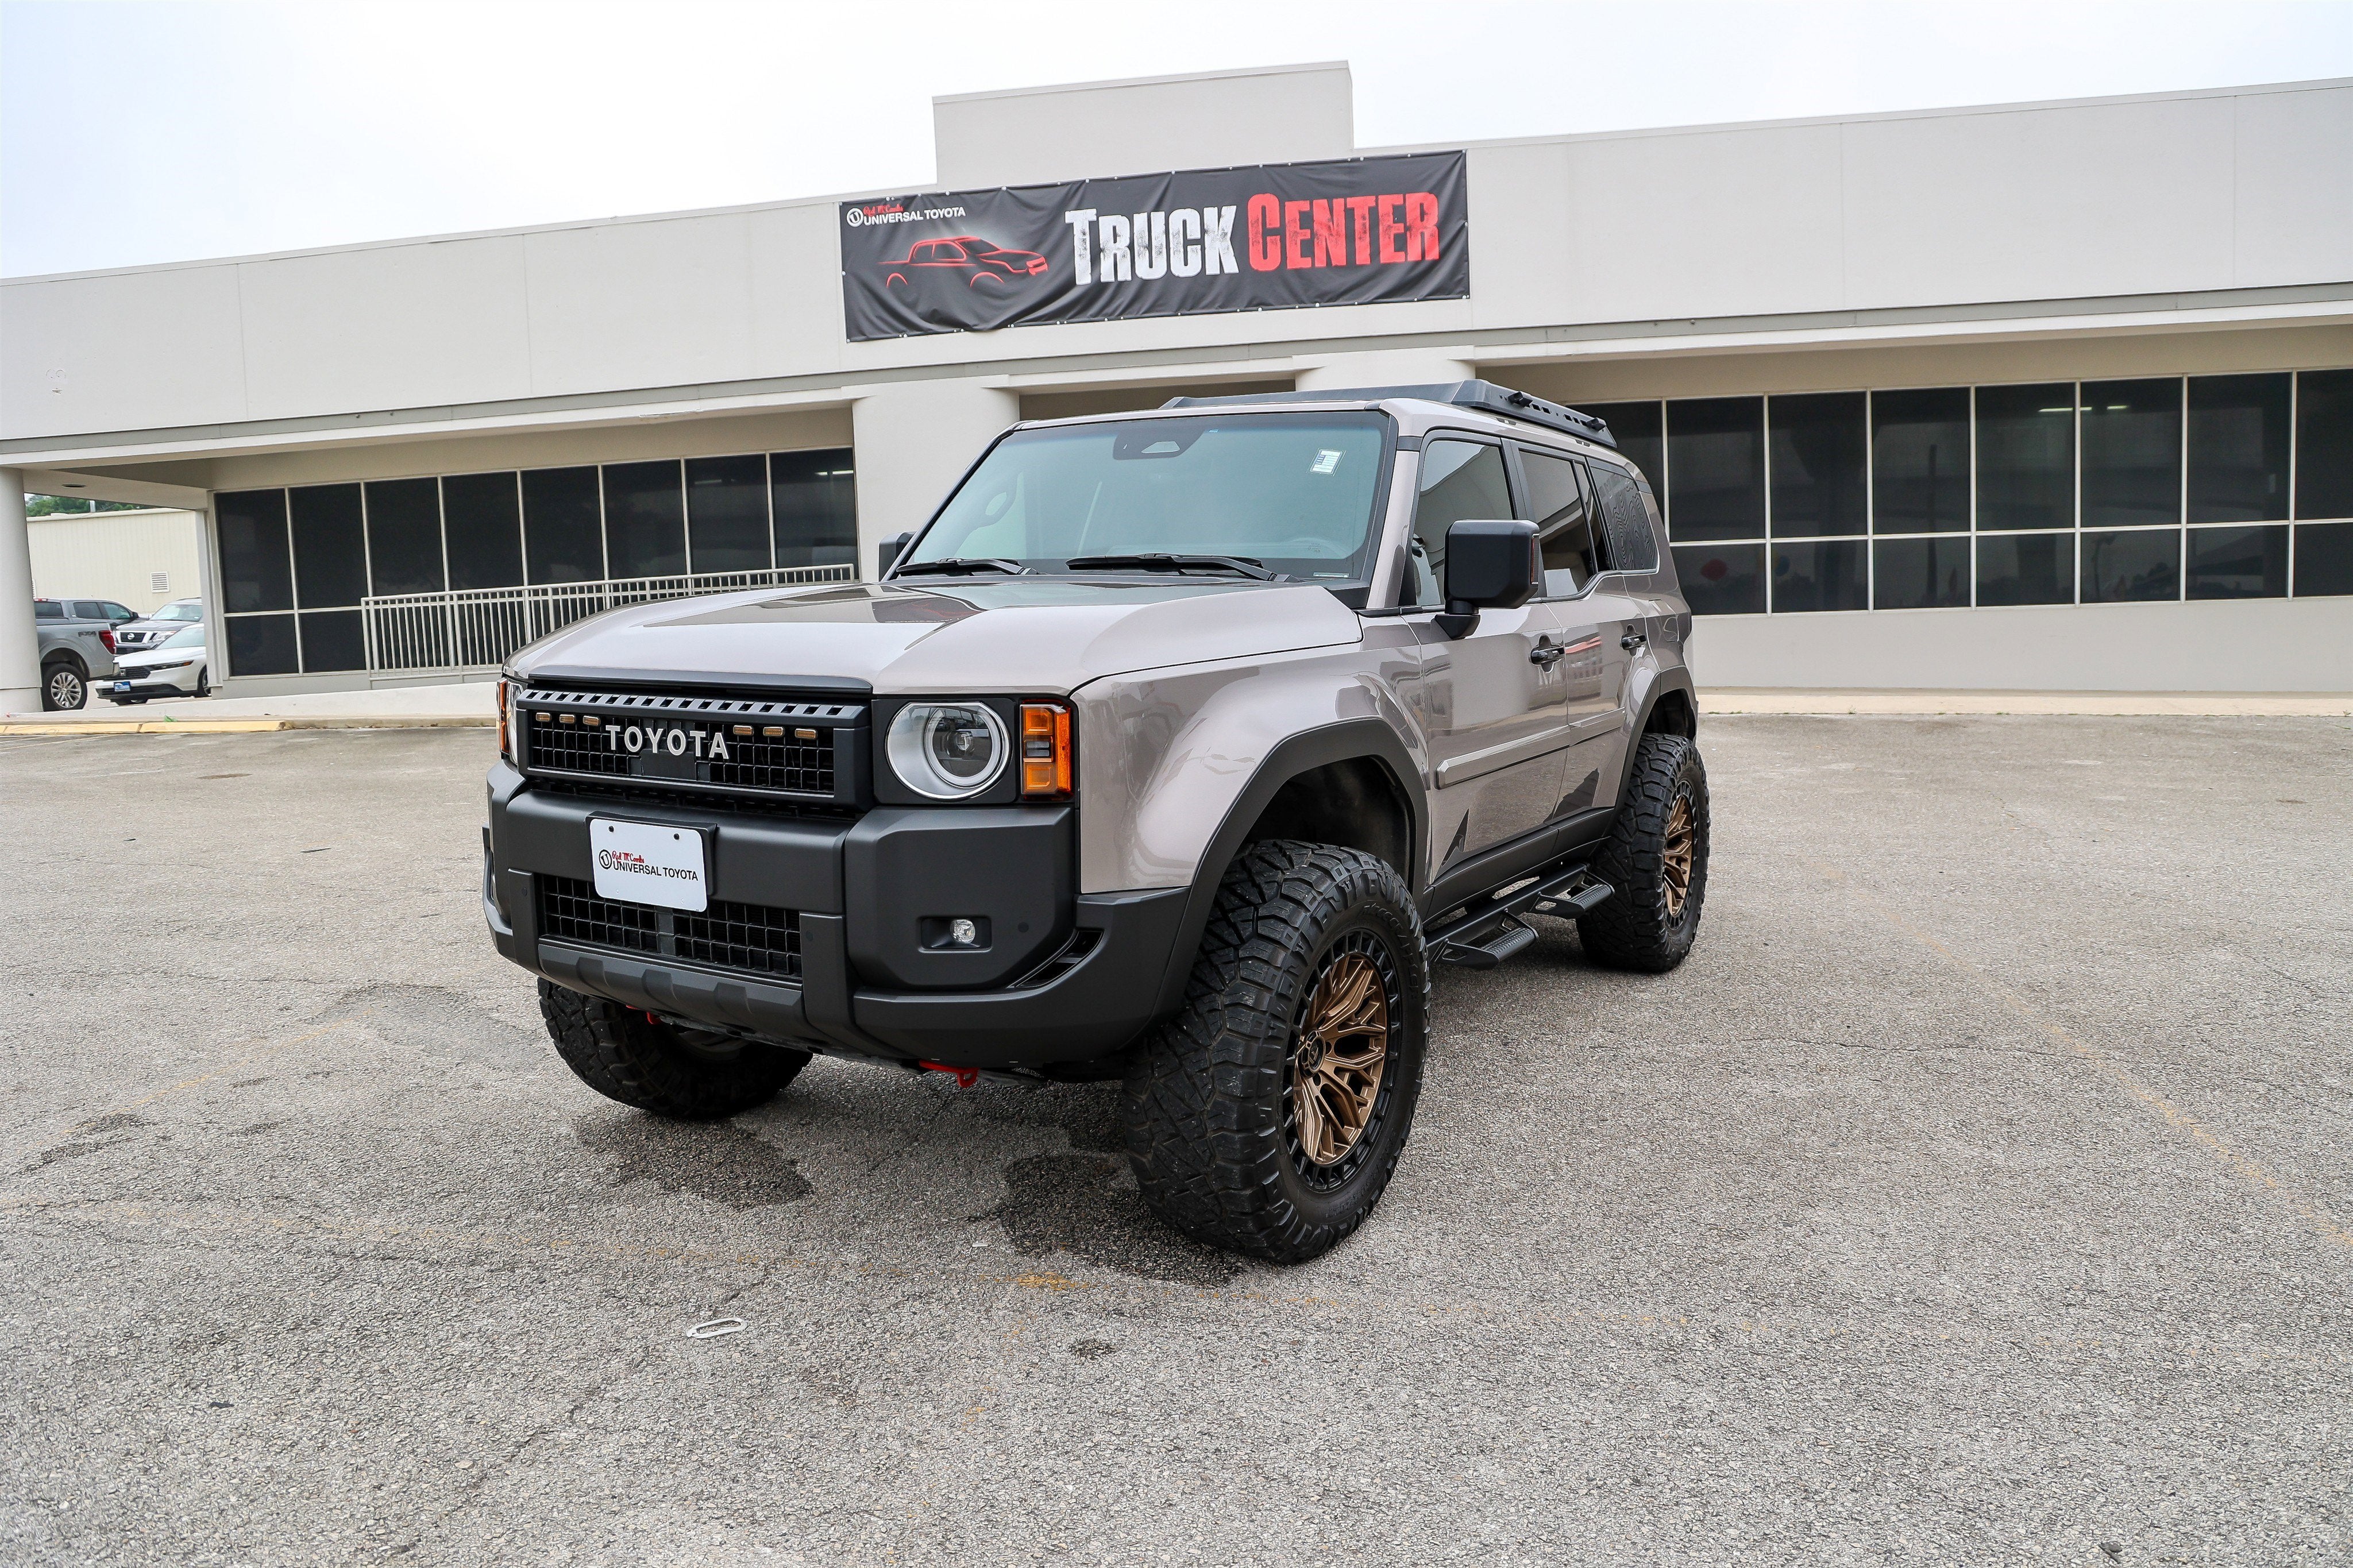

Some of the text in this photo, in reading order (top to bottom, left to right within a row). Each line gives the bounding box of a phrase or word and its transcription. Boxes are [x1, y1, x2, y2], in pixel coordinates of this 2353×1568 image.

[863, 207, 966, 226] UNIVERSAL TOYOTA
[1064, 191, 1440, 286] TRUCK CENTER
[605, 725, 730, 760] TOYOTA
[613, 860, 699, 881] UNIVERSAL TOYOTA
